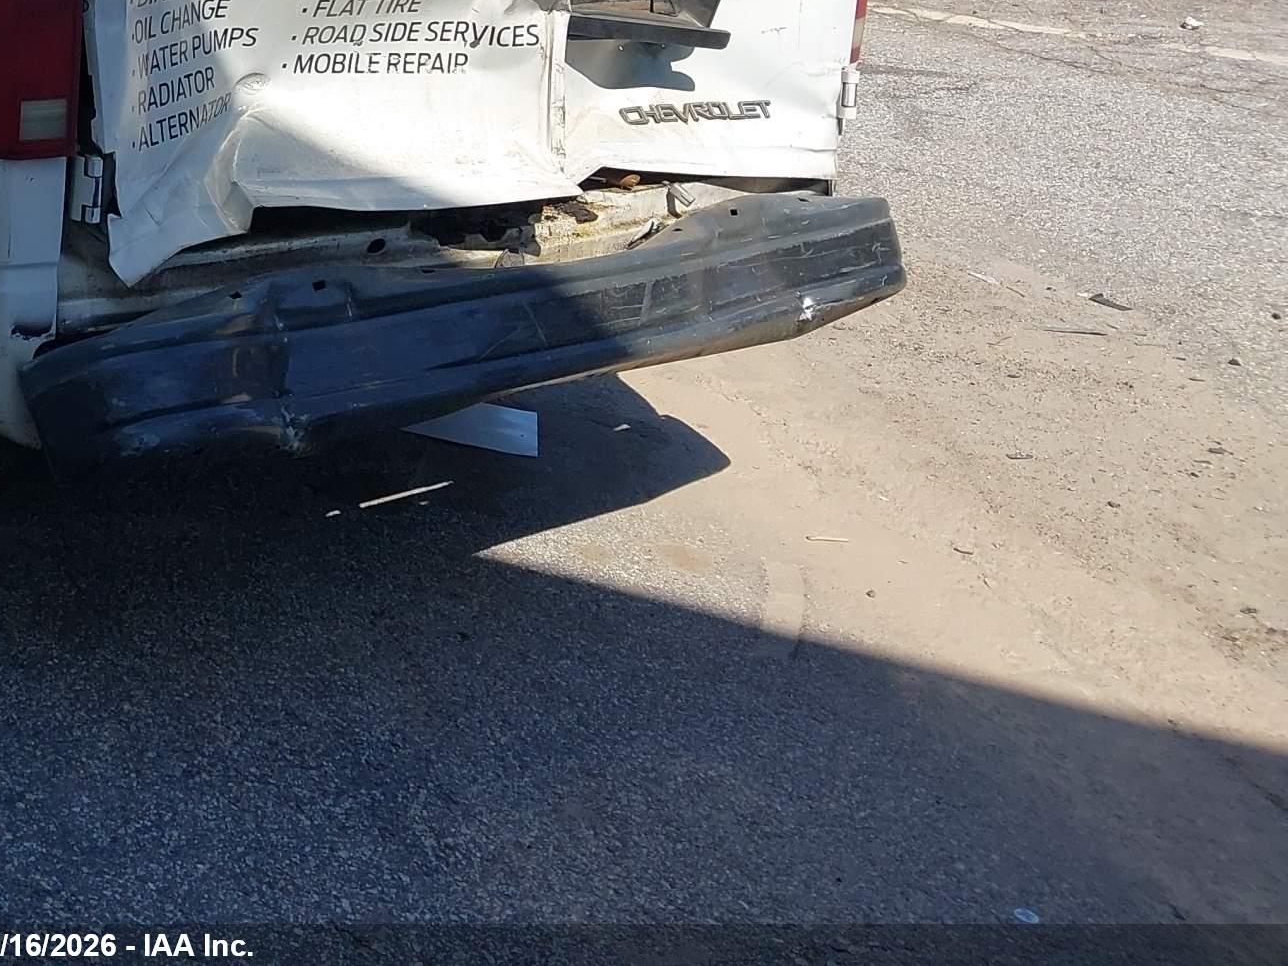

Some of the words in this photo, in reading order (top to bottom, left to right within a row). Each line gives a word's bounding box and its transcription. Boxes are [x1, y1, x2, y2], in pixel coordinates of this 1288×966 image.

[134, 17, 157, 44] OIL
[302, 24, 367, 46] ROAD
[369, 22, 422, 43] SIDE
[424, 21, 540, 47] SERVICES
[137, 40, 189, 80] WATER
[192, 27, 259, 60] PUMPS
[293, 53, 381, 74] MOBILE
[386, 52, 469, 74] REPAIR
[138, 66, 215, 116] RADIATOR
[138, 91, 232, 152] ALTERNATOR
[619, 100, 771, 125] CHEVROLET
